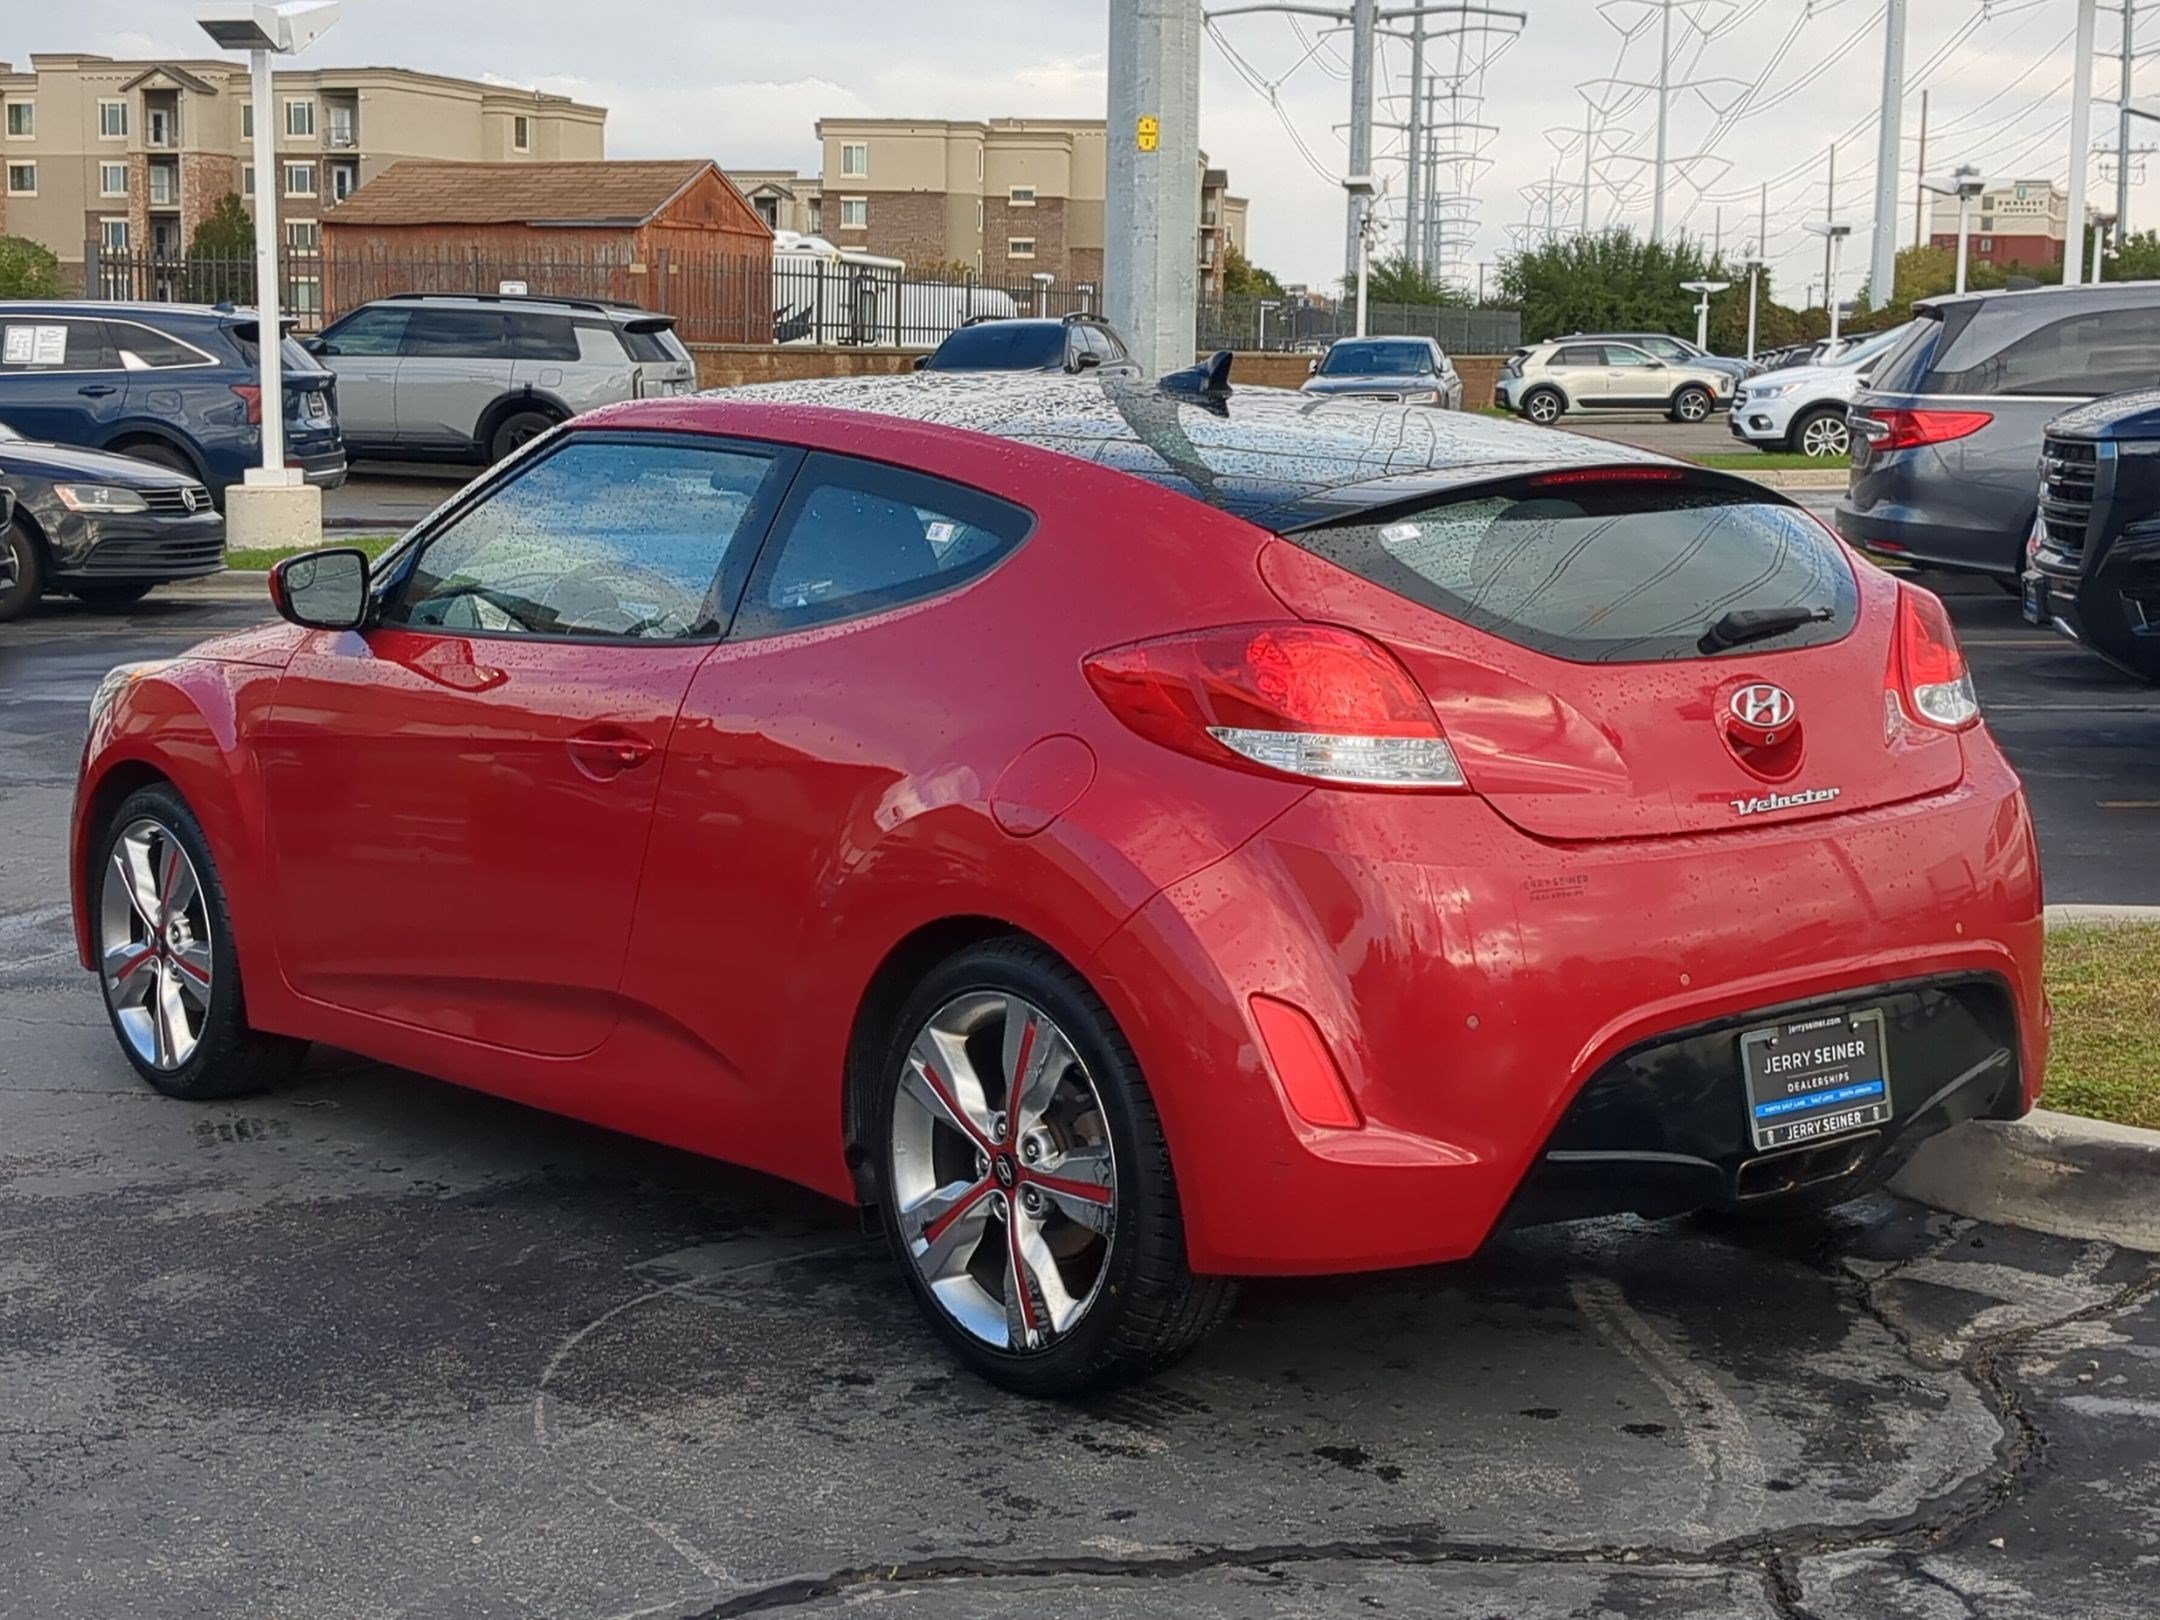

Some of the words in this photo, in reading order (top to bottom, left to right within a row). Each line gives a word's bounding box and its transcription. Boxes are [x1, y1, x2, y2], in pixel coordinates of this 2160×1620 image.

[1730, 787, 1840, 815] Veloster
[1788, 1017, 1842, 1034] jerryseiner.com
[1764, 1050, 1811, 1074] JERRY
[1815, 1041, 1865, 1063] SEINER
[1787, 1072, 1850, 1093] DEALERSHIPS
[1787, 1121, 1822, 1140] JERRY
[1823, 1112, 1861, 1132] SEINER
